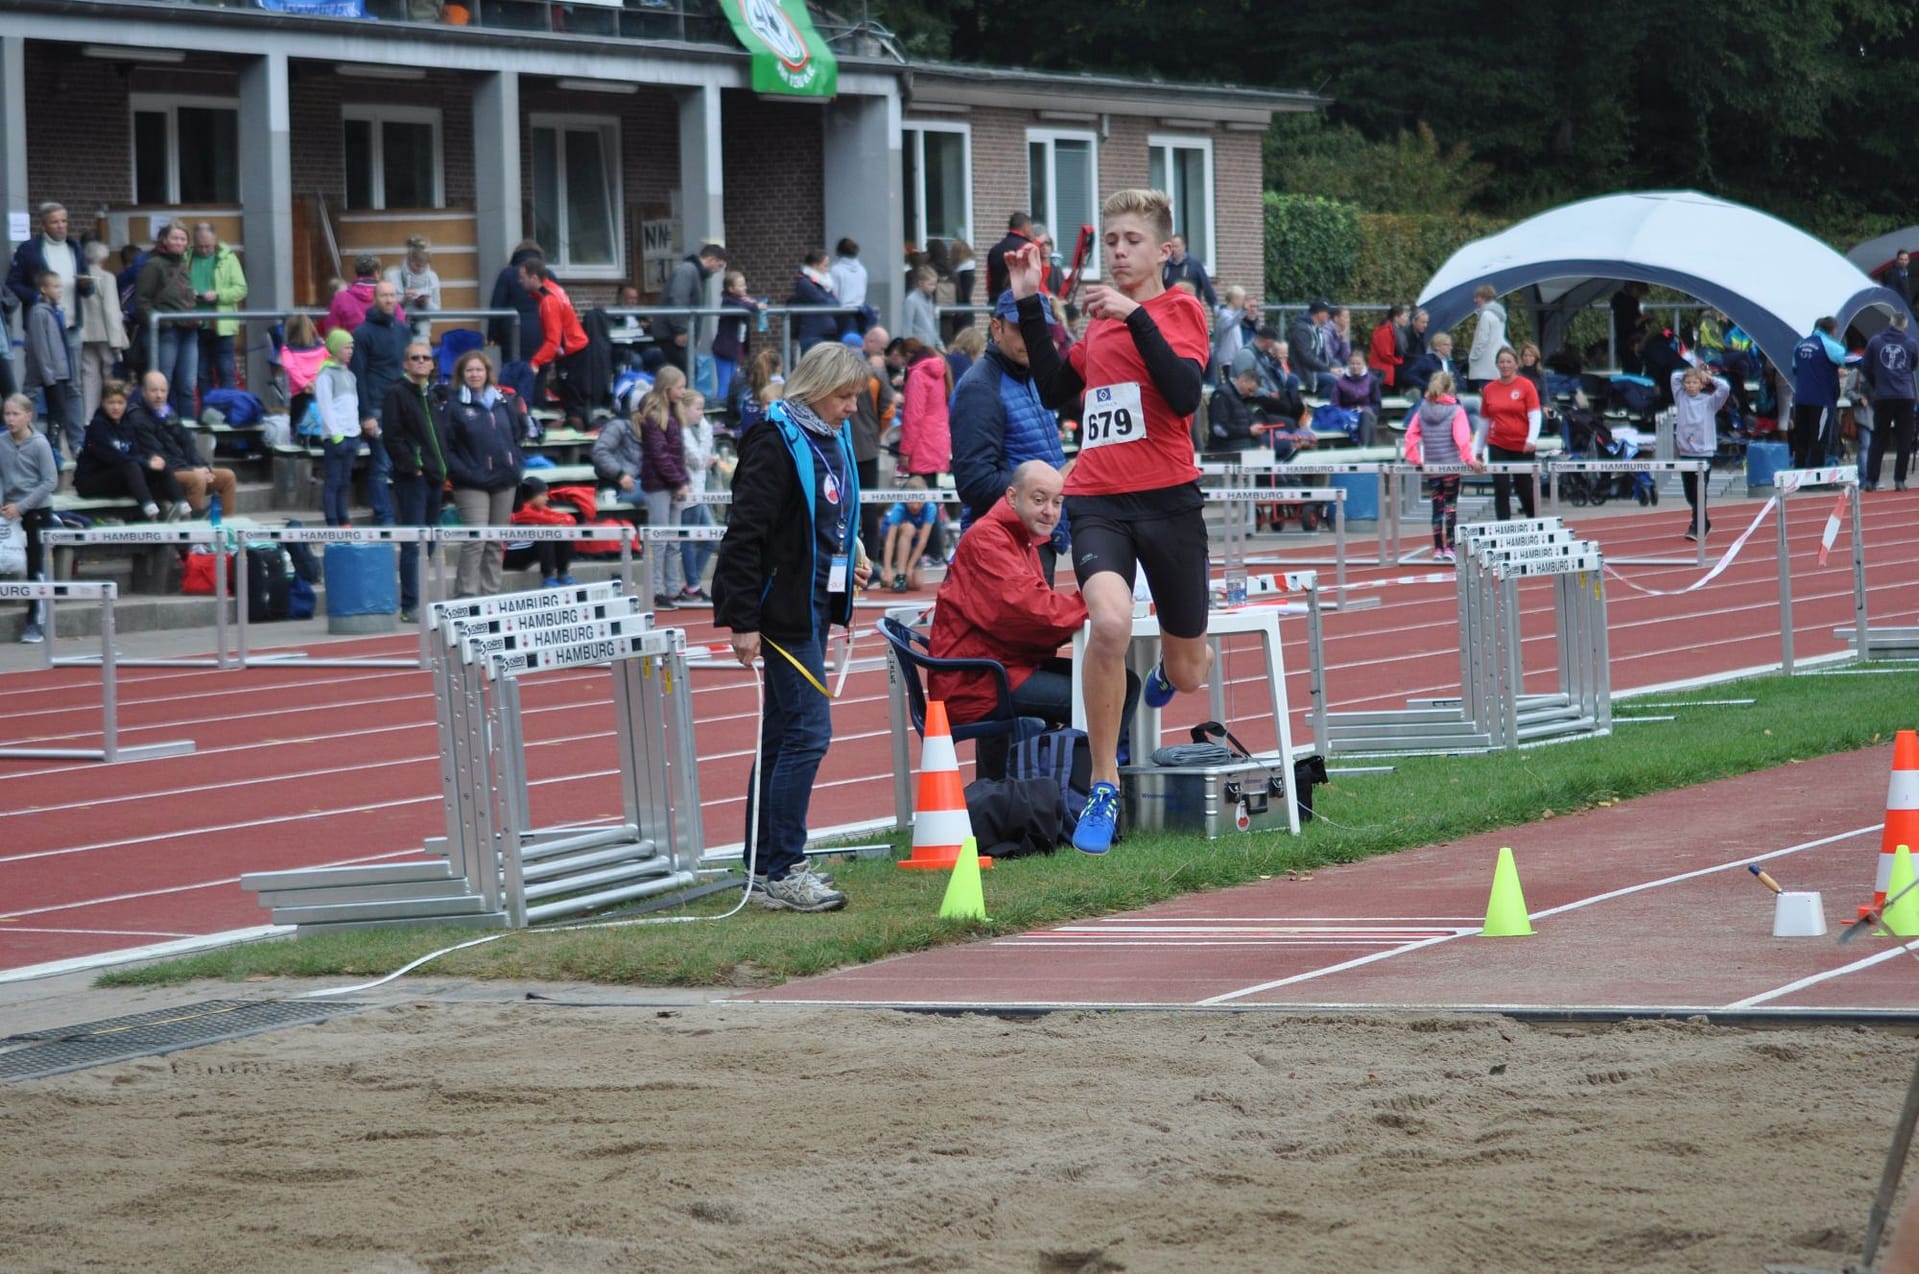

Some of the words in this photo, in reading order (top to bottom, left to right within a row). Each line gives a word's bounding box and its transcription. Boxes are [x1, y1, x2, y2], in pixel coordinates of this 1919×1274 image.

[1088, 408, 1133, 441] 679
[1286, 465, 1335, 473] HAMBURG
[1600, 463, 1651, 471] HAMBURG
[871, 493, 926, 502] HAMBURG
[1227, 491, 1284, 500] HAMBURG
[300, 531, 362, 540] HAMBURG
[500, 530, 562, 539] HAMBURG
[1495, 523, 1529, 536] HAMBURG
[103, 532, 162, 541] HAMBURG
[1506, 535, 1539, 547] HAMBURG
[1520, 547, 1553, 560] HAMBURG
[1536, 560, 1569, 574] HAMBURG
[499, 594, 559, 613] HAMBURG
[519, 609, 578, 630] HAMBURG
[535, 626, 594, 647] HAMBURG
[556, 641, 615, 665] HAMBURG
